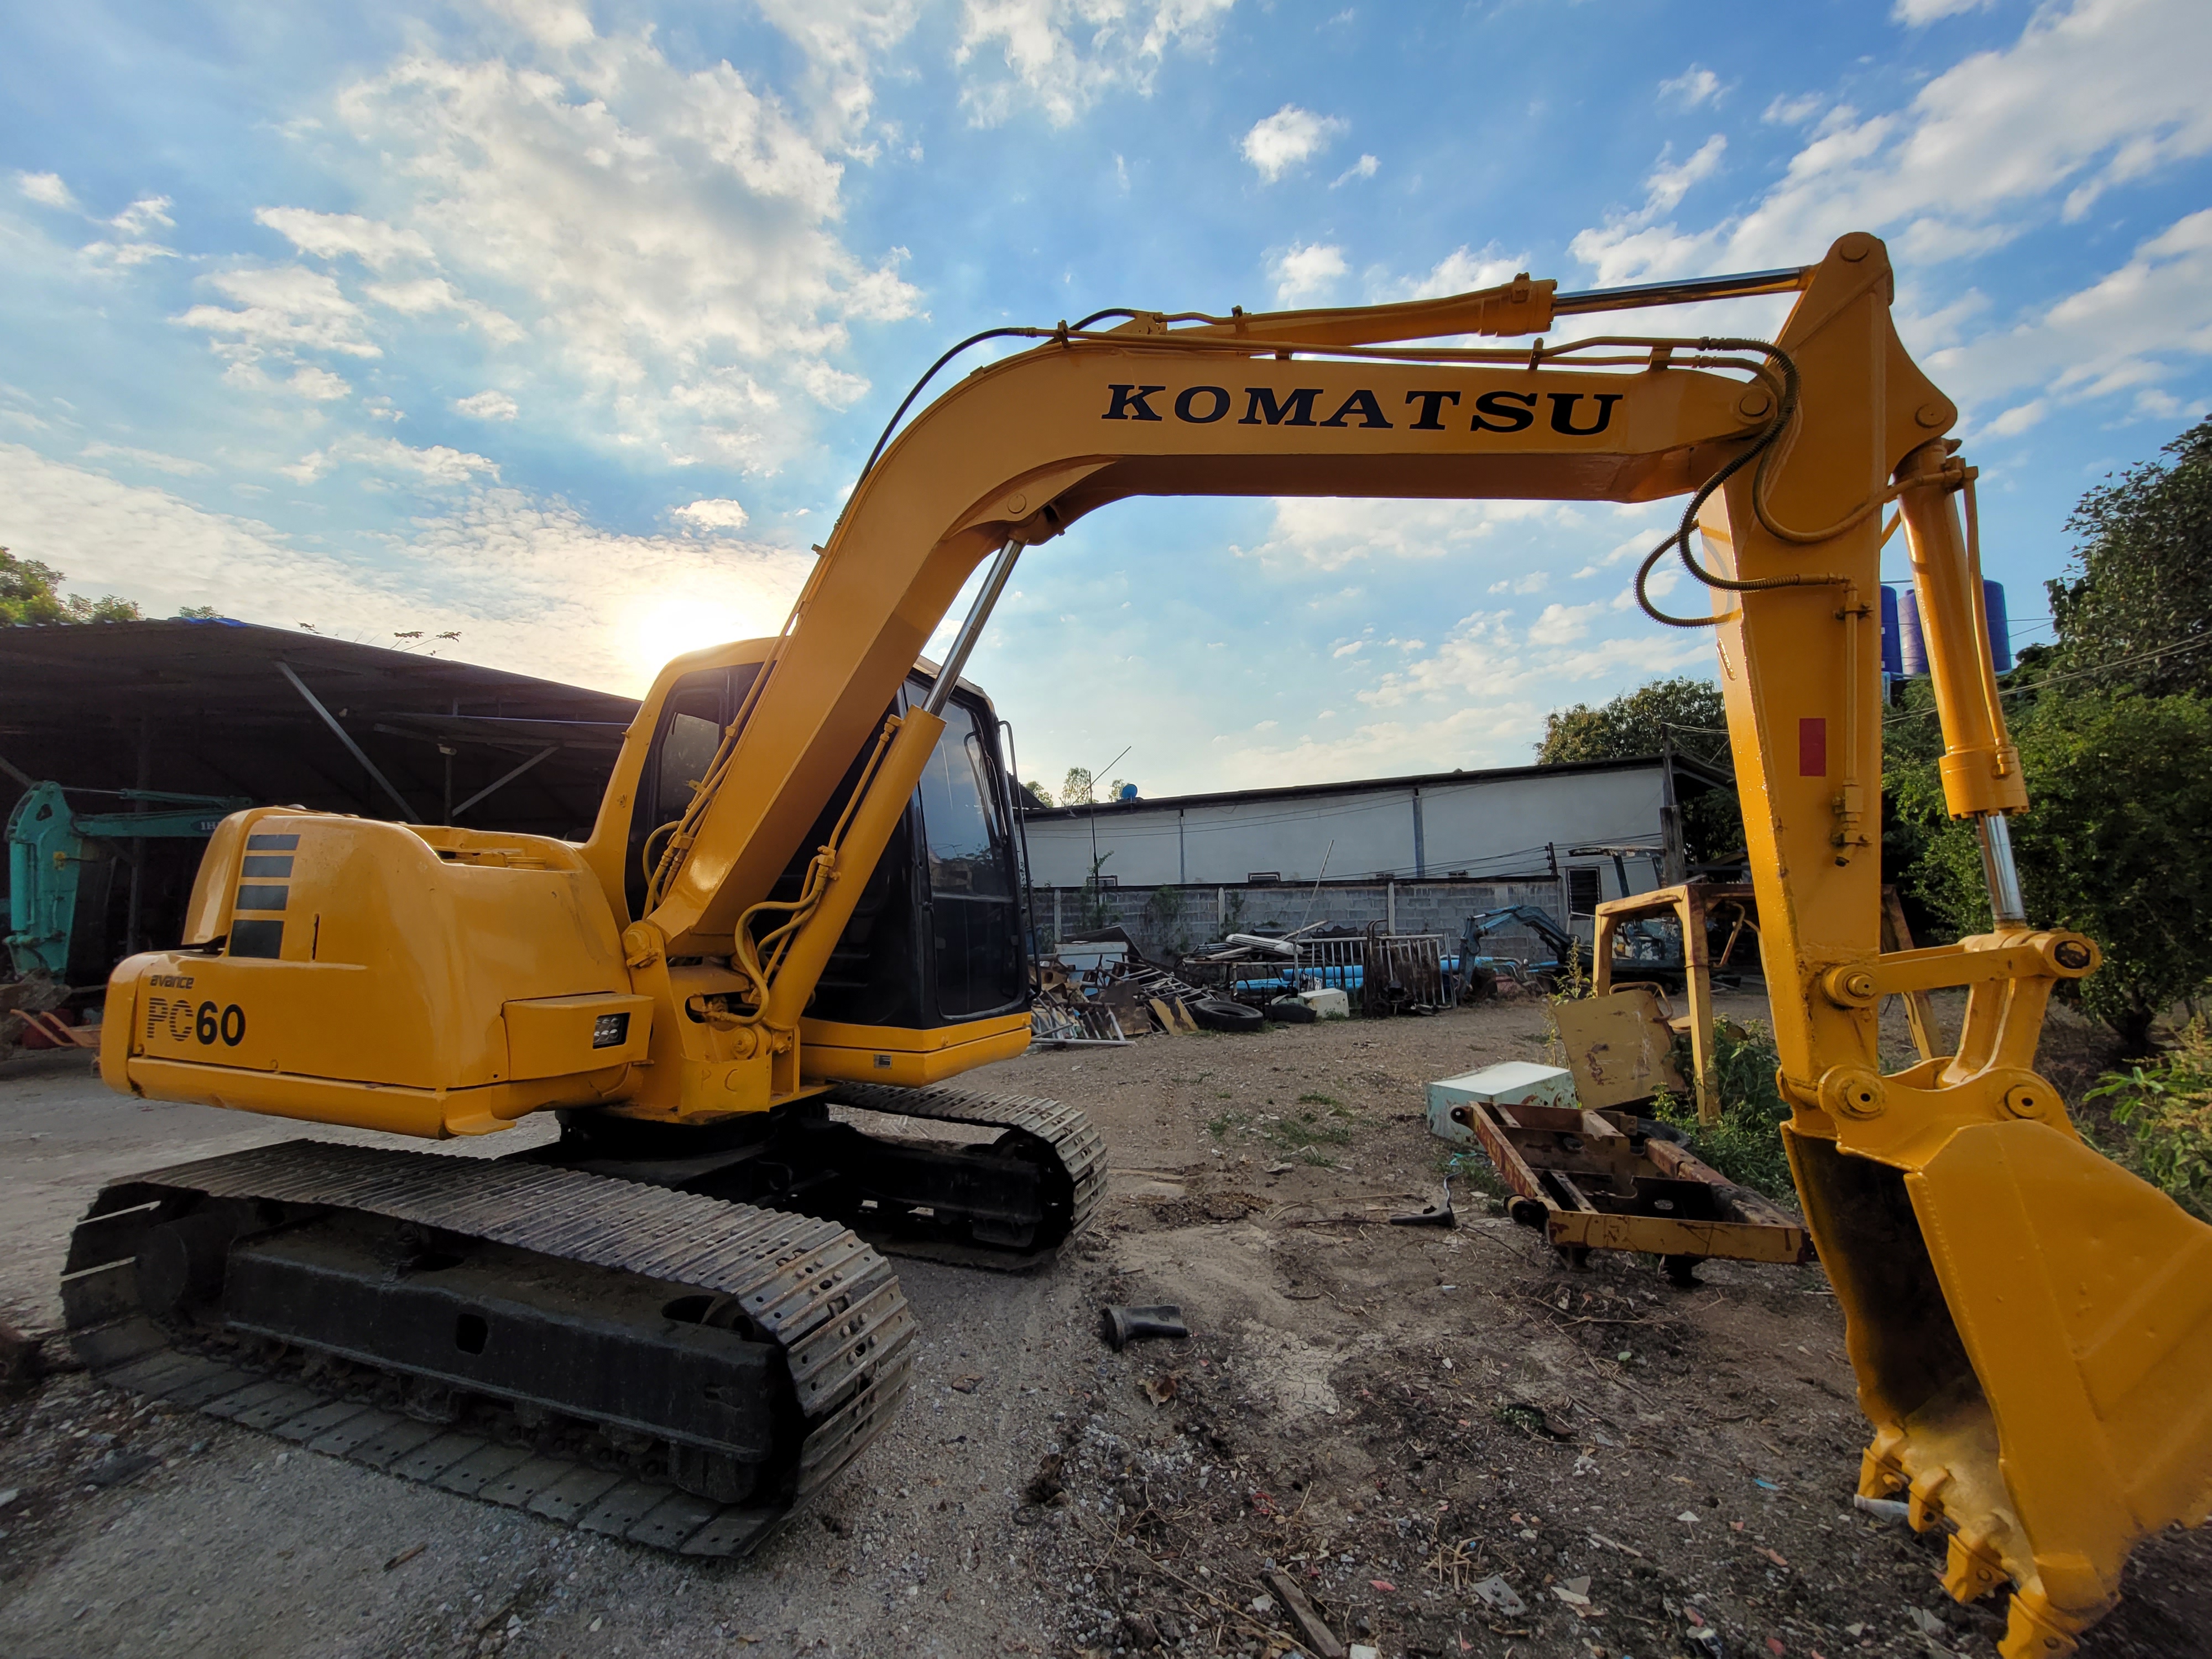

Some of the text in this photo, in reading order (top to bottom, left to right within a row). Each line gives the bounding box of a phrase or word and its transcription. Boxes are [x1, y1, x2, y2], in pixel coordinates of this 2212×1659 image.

[1101, 384, 1623, 436] KOMATSU
[201, 822, 221, 830] IH
[150, 975, 194, 989] avance
[147, 997, 246, 1046] PC60
